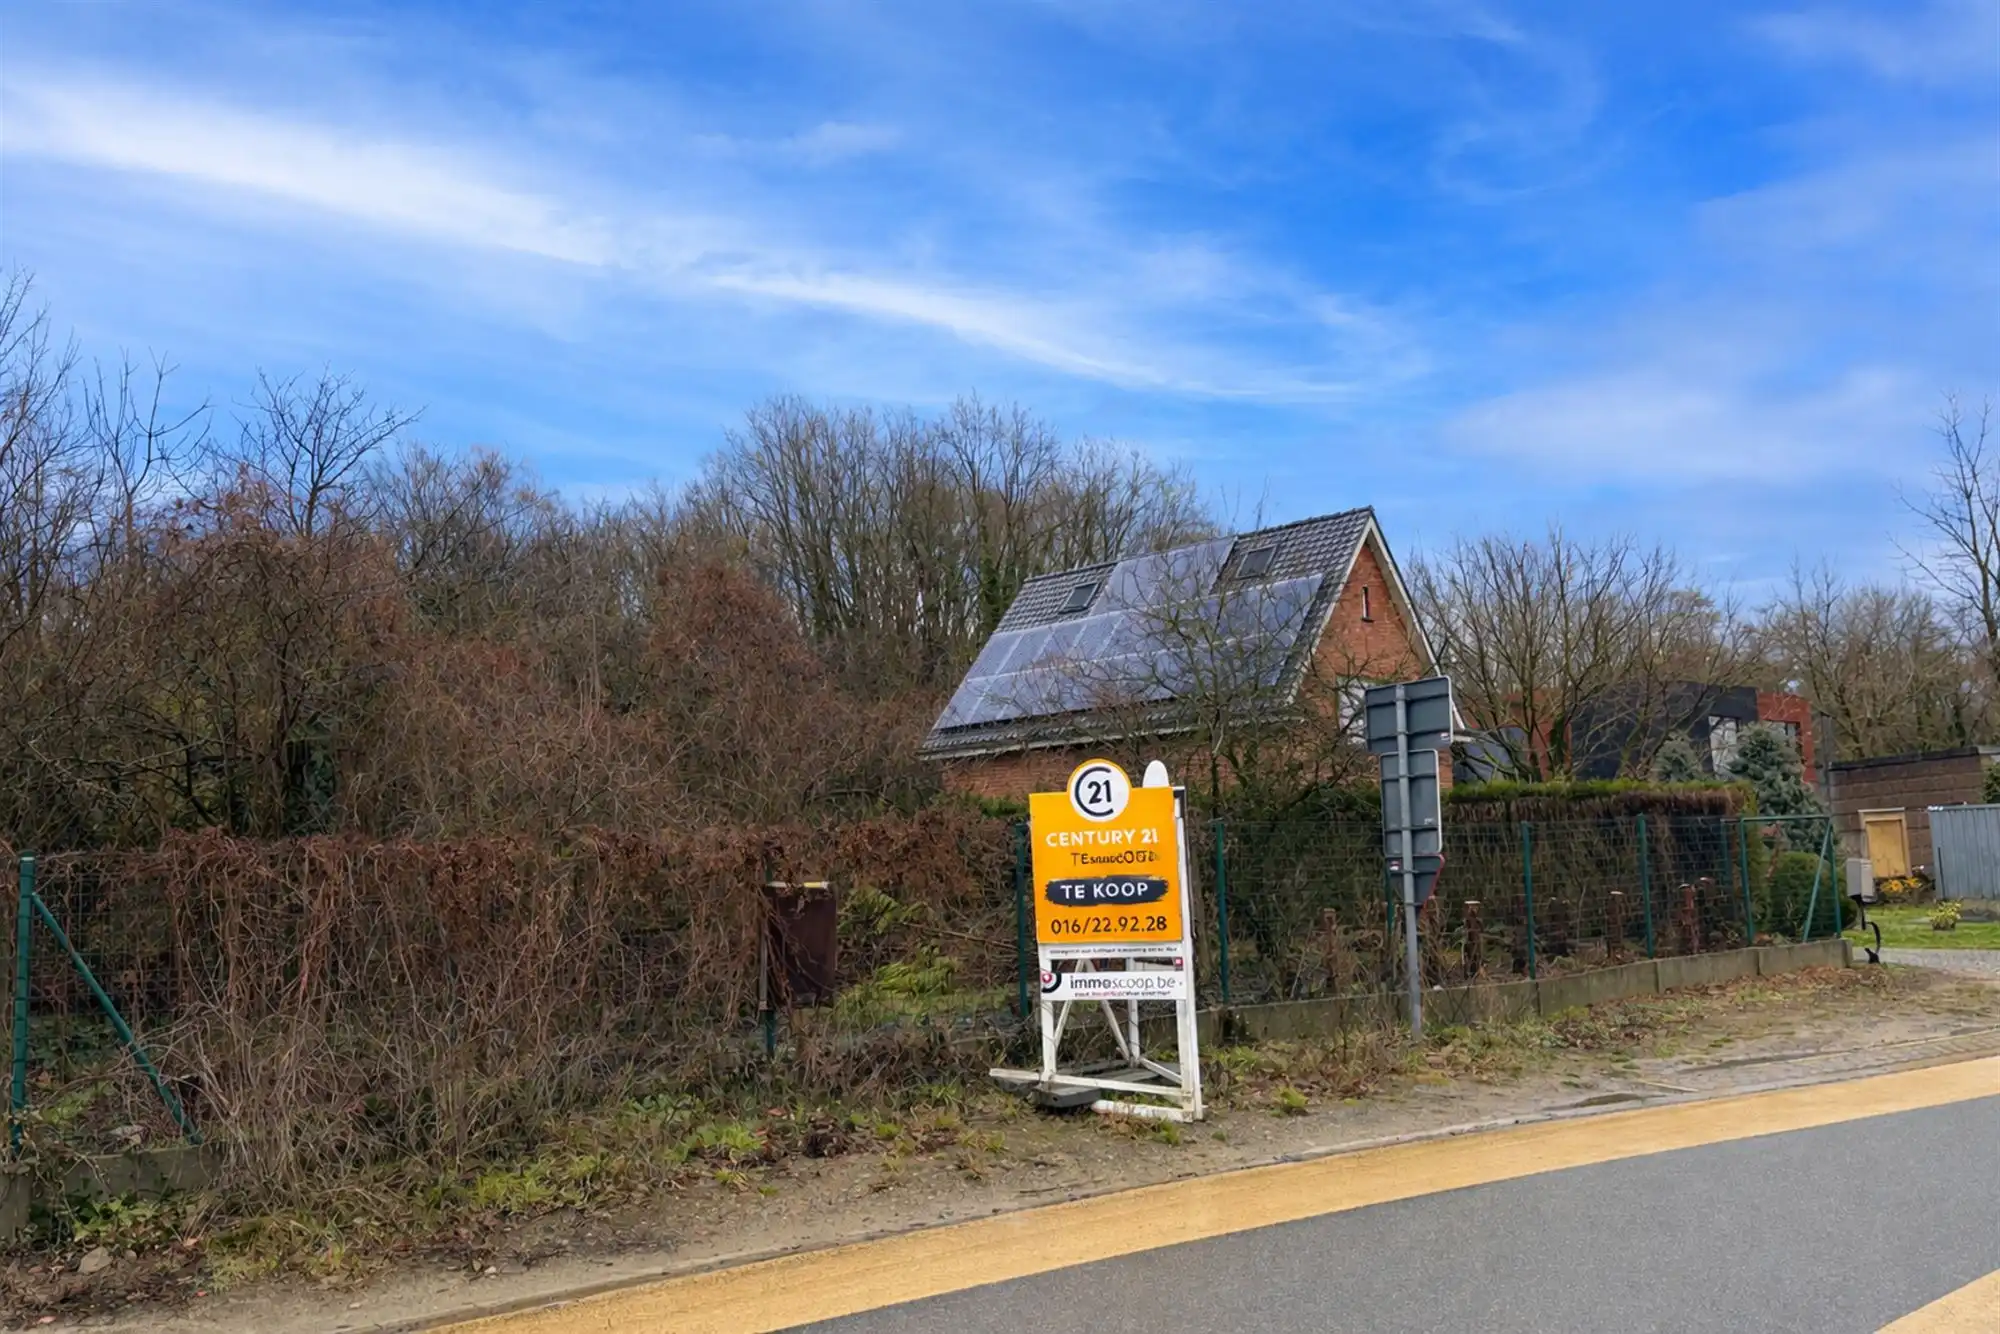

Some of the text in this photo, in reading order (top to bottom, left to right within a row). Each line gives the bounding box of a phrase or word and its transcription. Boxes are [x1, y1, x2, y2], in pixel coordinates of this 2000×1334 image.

[1045, 828, 1160, 848] CENTURY 21
[1060, 882, 1149, 899] TE KOOP
[1050, 916, 1168, 935] 016/22.92.28
[1070, 975, 1176, 990] immoscoop.be
